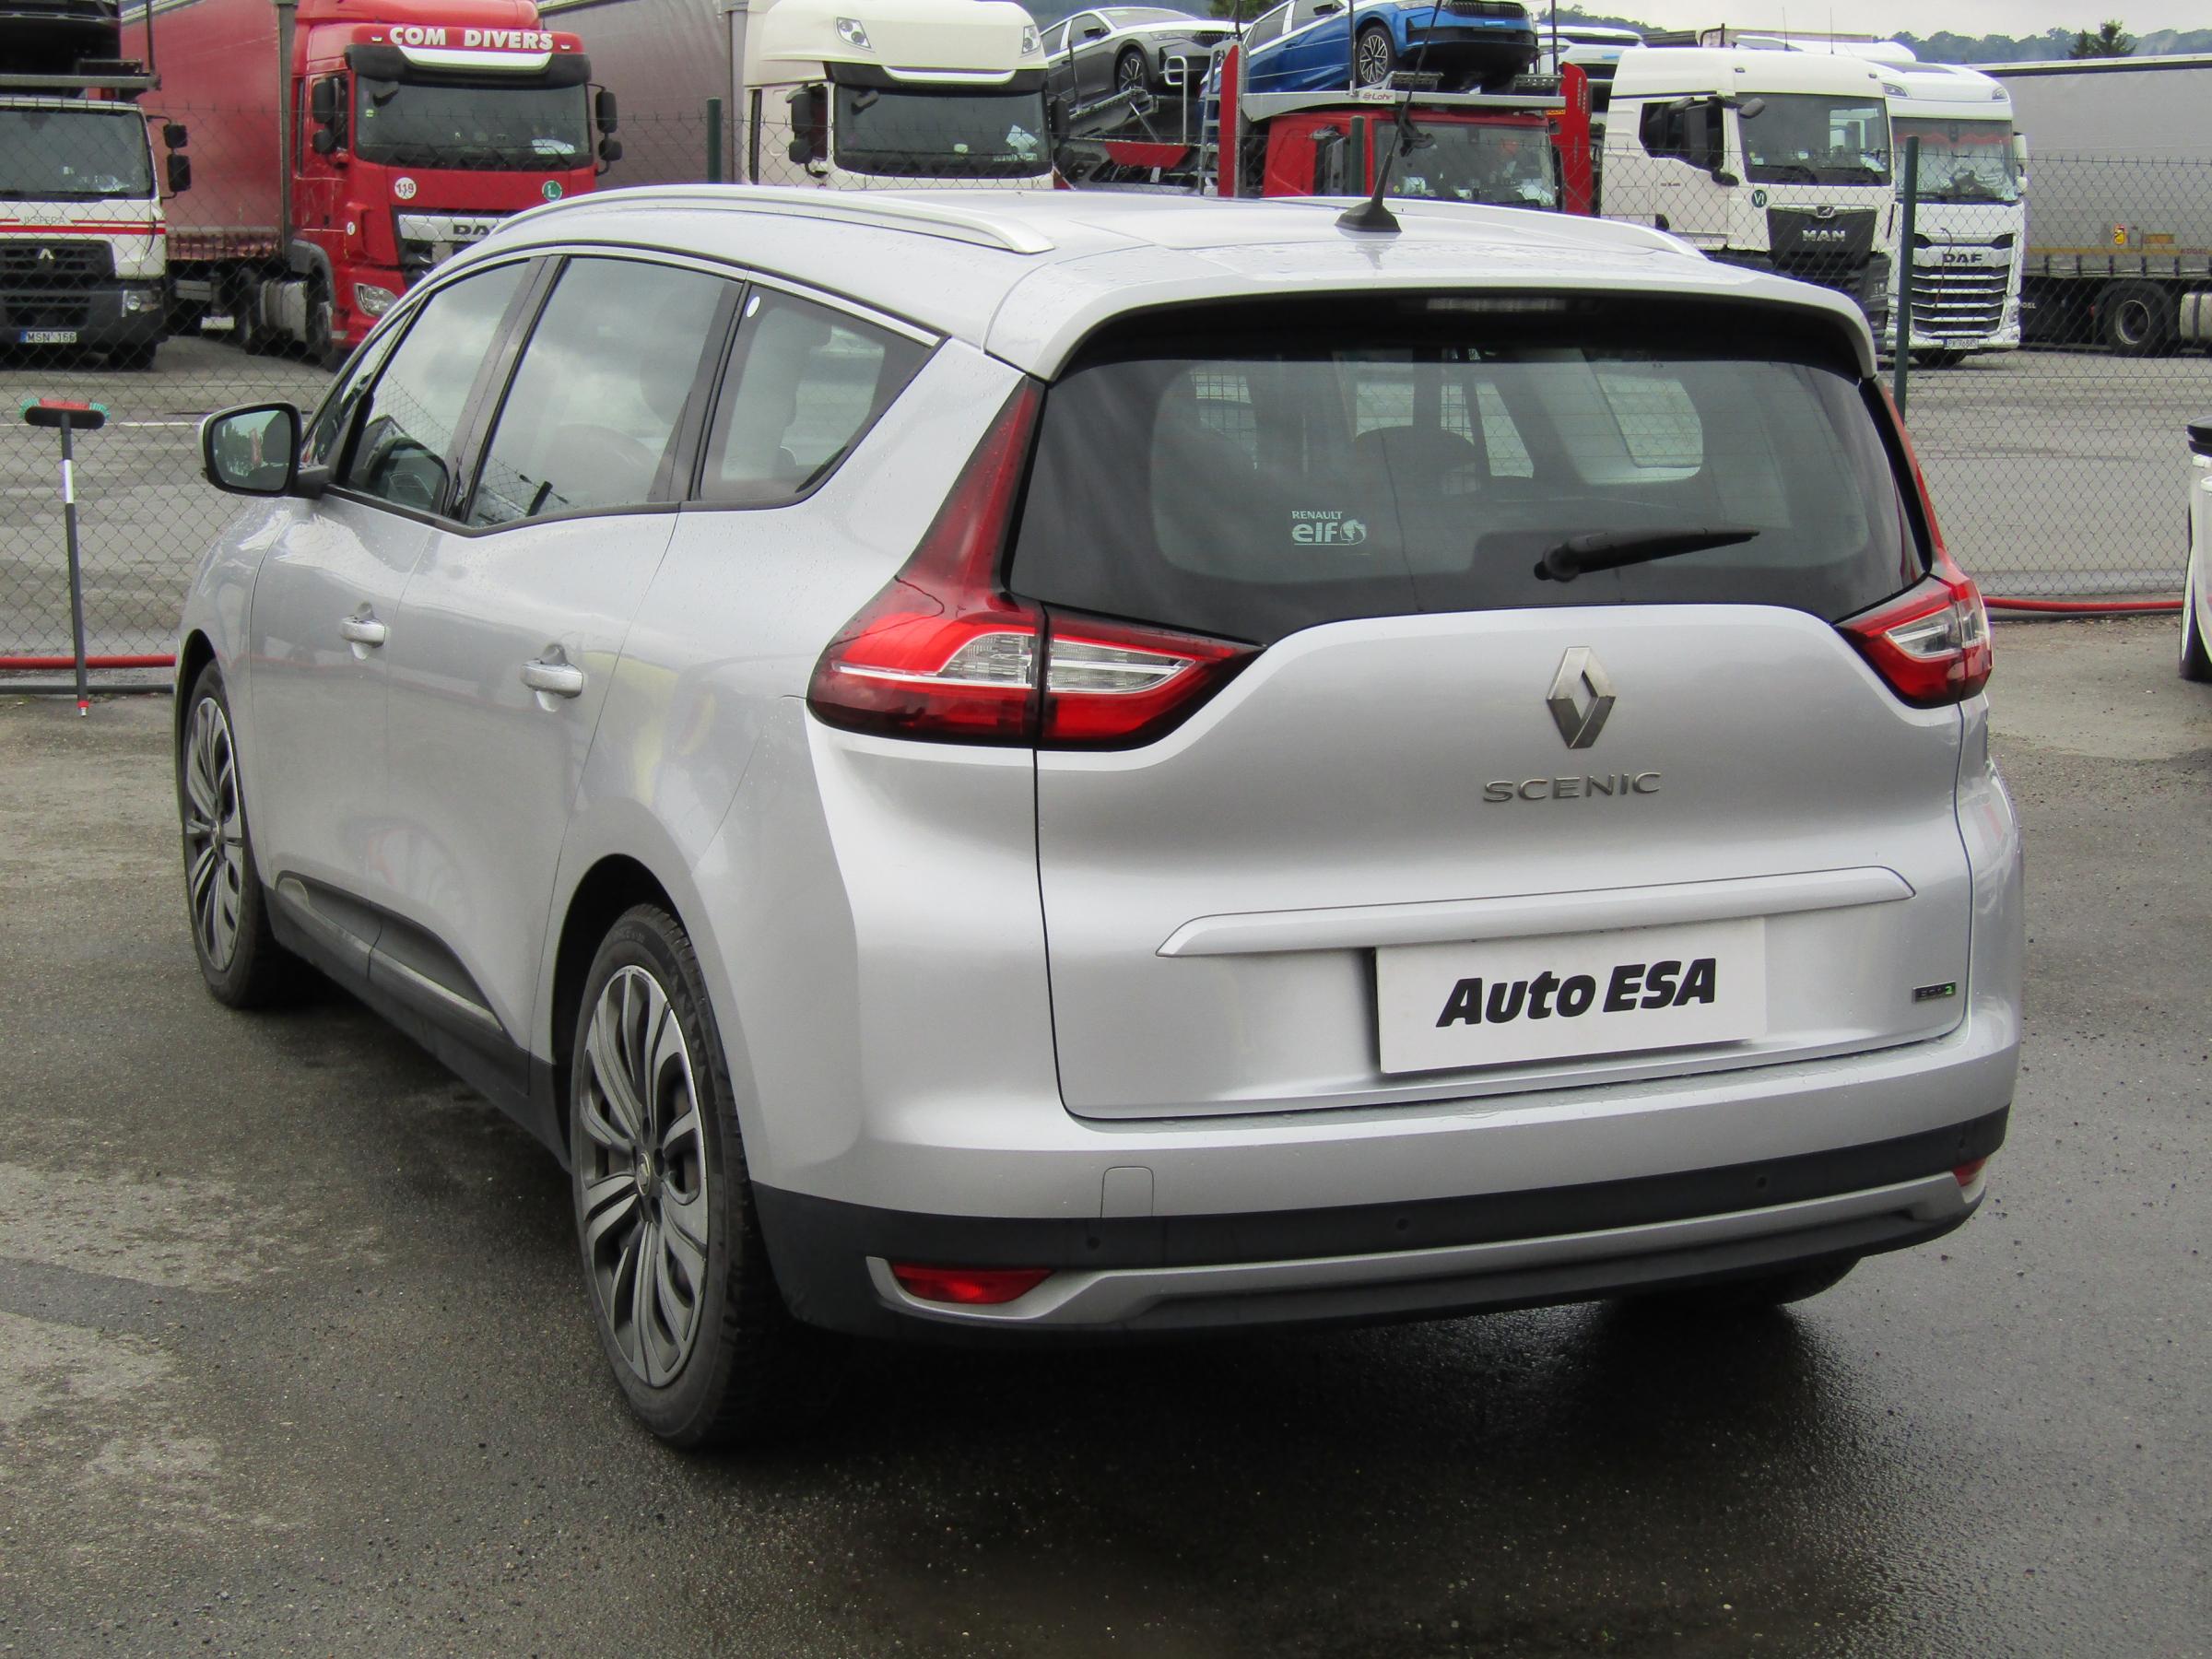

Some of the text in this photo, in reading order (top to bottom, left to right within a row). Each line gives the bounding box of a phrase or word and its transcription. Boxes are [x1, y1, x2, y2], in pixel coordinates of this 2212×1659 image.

[390, 27, 553, 51] COM DIVERS
[396, 182, 414, 194] 119
[453, 223, 490, 236] DA
[1802, 229, 1846, 242] MAN
[1942, 253, 1983, 264] DAF
[1291, 511, 1343, 520] RENAULT
[1291, 522, 1338, 543] elf
[1482, 771, 1662, 803] SCENIC
[1435, 958, 1716, 1028] Auto ESA
